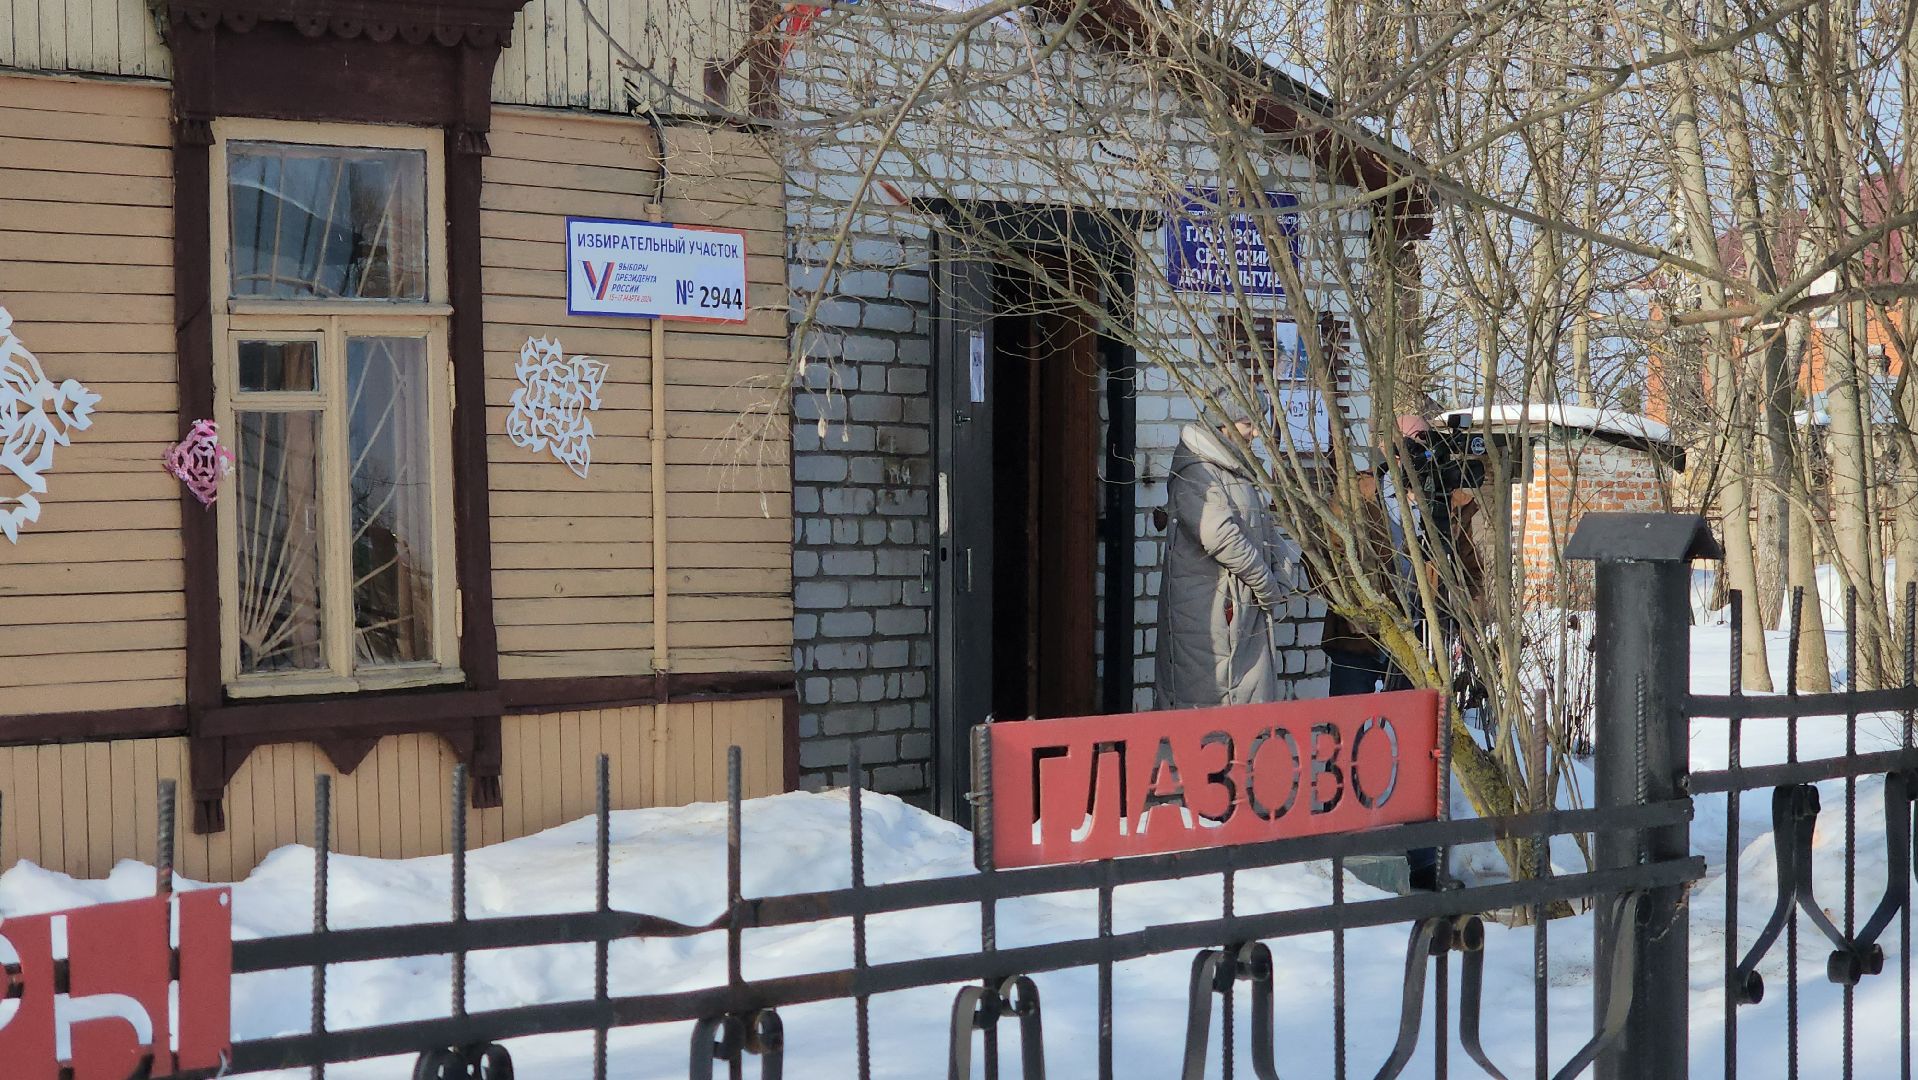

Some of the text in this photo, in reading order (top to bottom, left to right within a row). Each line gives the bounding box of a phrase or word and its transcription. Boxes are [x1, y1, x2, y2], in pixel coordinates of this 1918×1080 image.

[577, 233, 739, 259] ИЗБИРАТЕЛЬНЫЙ УЧАСТОК
[618, 262, 649, 272] ВЫБОРЫ
[614, 273, 657, 284] ПРЕЗИДЕНТА
[611, 283, 640, 294] РОССИИ
[676, 280, 743, 310] № 2944
[1031, 716, 1400, 845] ГЛАЗОВО
